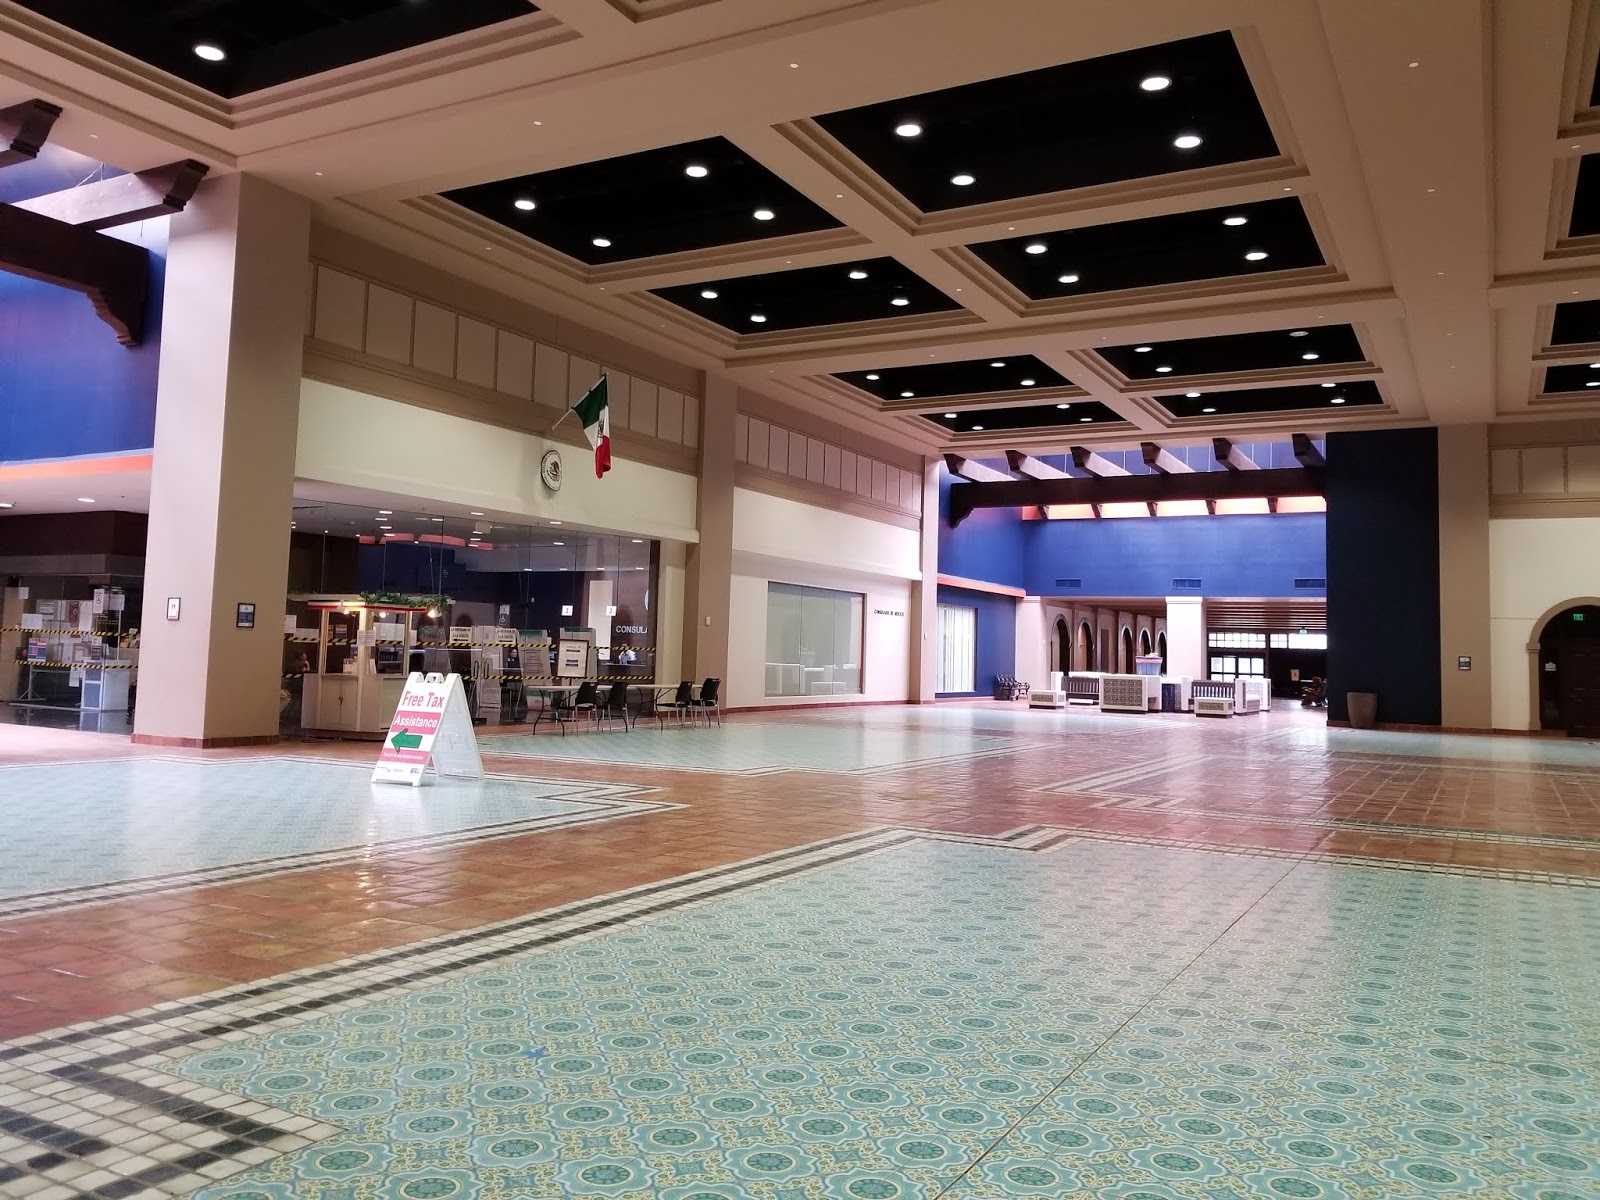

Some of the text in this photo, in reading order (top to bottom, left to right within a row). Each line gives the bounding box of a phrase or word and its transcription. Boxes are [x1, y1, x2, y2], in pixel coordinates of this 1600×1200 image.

[402, 690, 445, 708] Free Tax
[393, 714, 438, 728] Assistance
